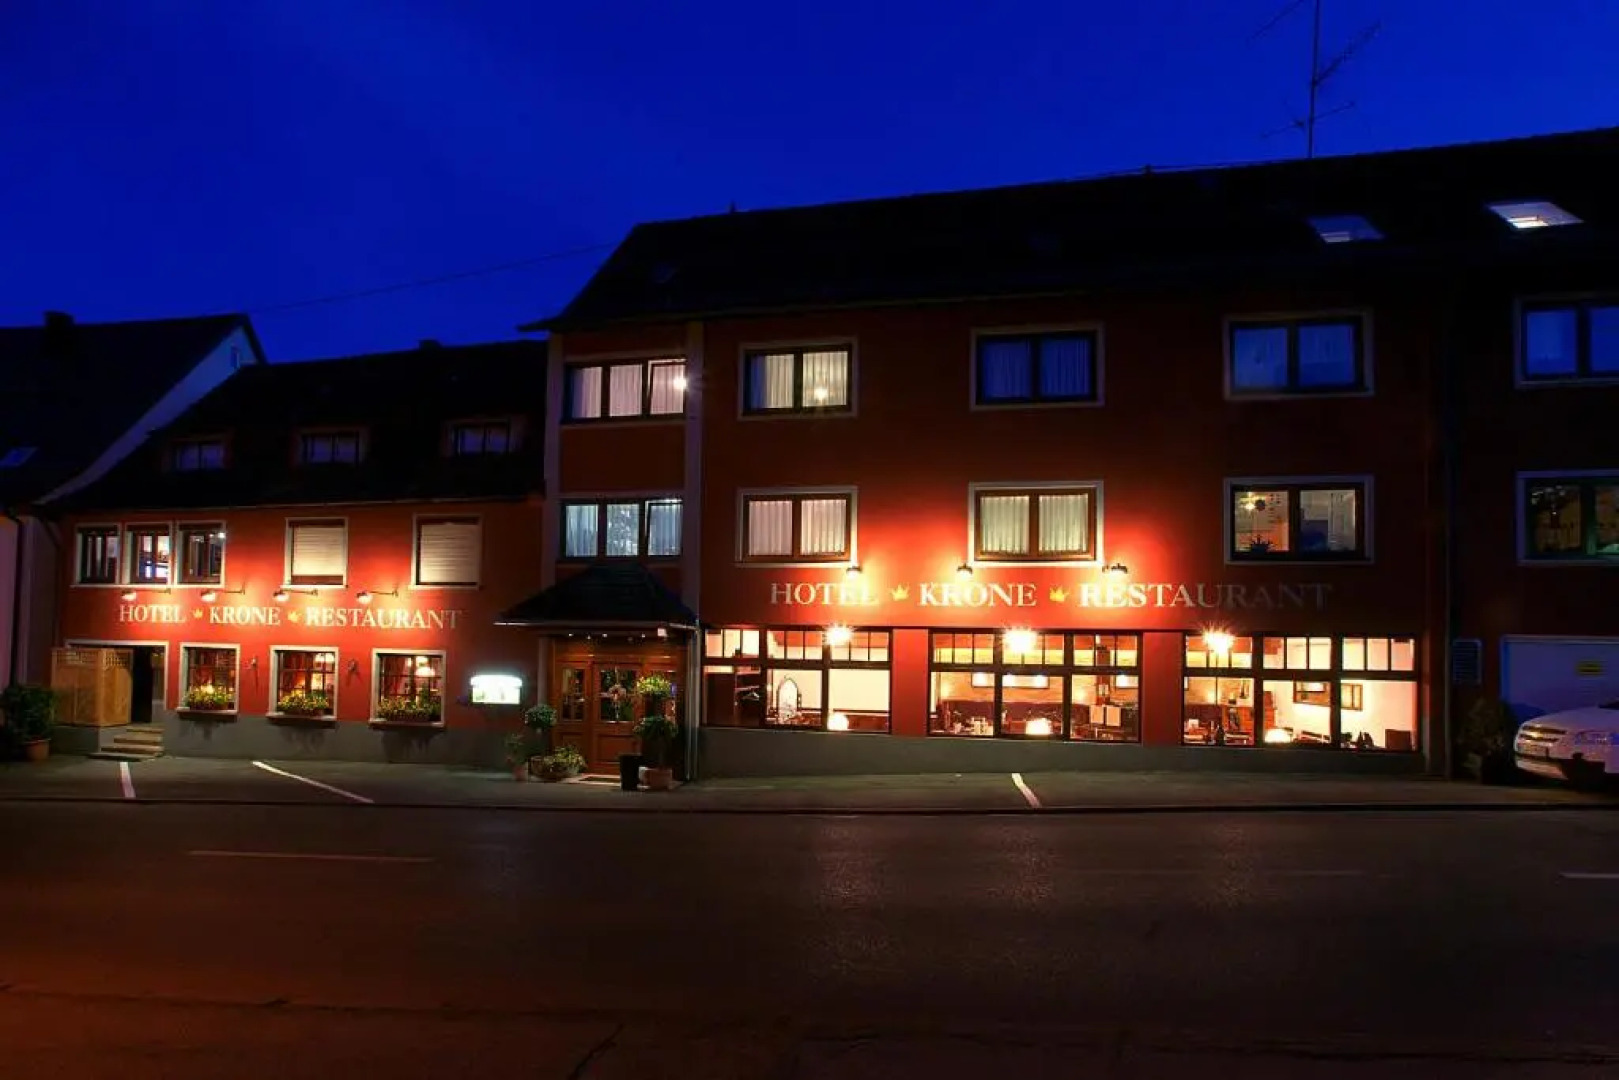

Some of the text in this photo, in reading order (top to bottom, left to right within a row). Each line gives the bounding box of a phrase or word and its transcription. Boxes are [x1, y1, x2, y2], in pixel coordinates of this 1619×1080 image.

[770, 582, 1334, 611] HOTEL KRONE RESTAURANT
[119, 604, 462, 629] HOTEL KRONE RESTAURANT
